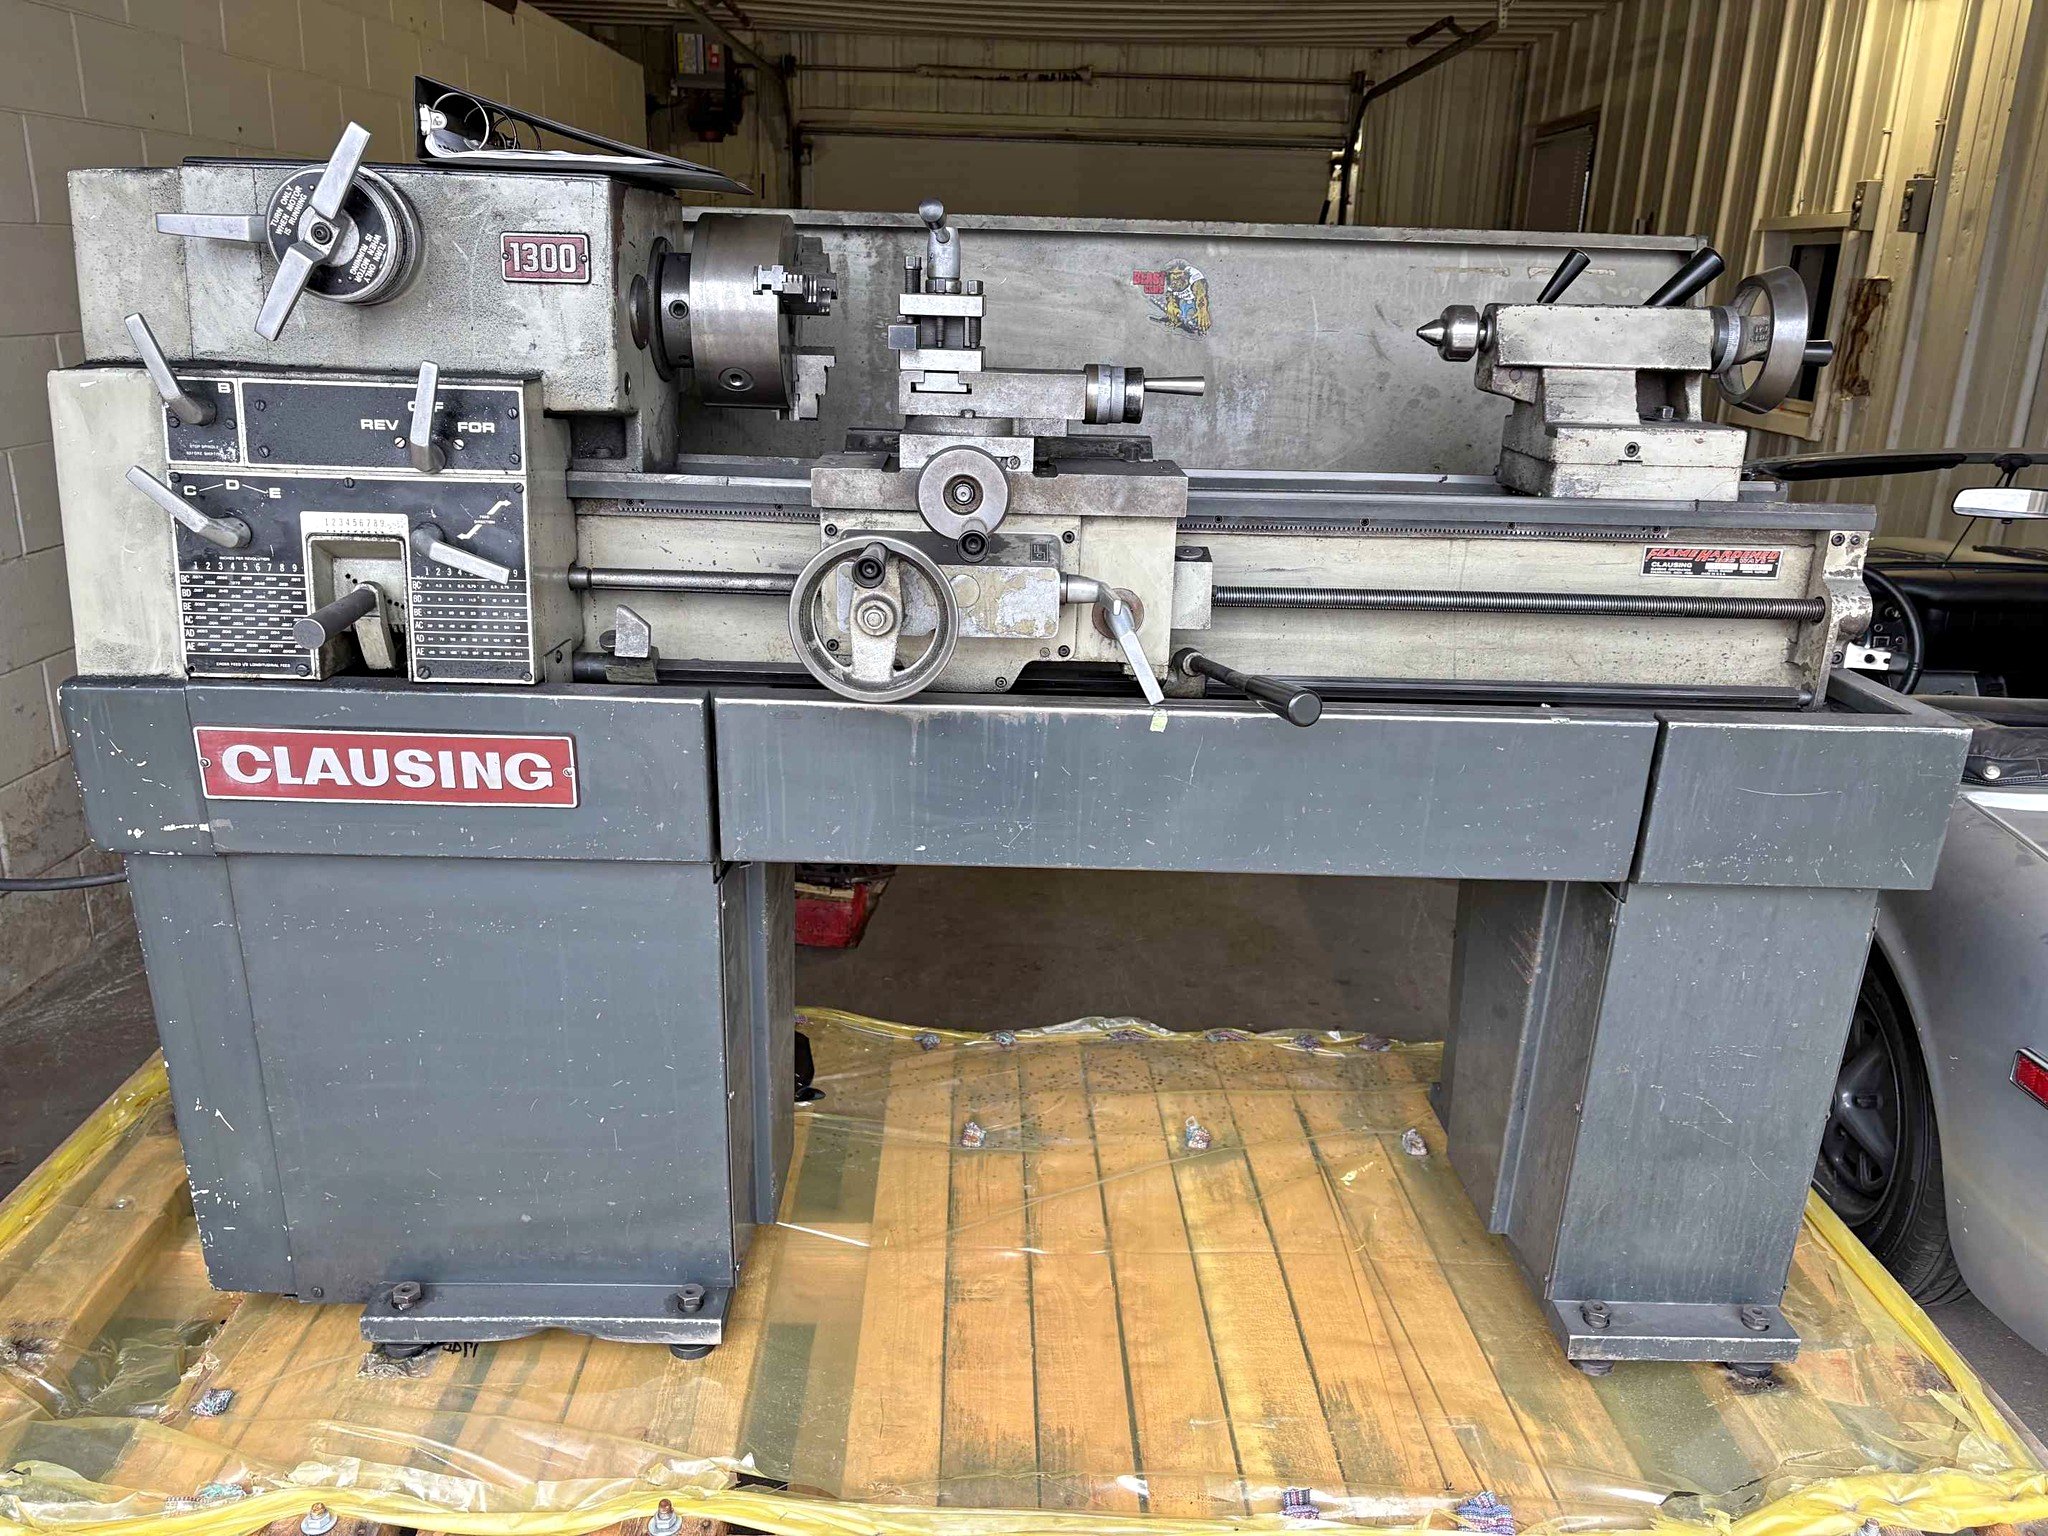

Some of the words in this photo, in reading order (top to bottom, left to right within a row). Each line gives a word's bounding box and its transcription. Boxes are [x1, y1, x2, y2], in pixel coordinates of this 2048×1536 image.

[270, 207, 283, 227] TURN
[280, 184, 294, 206] ONLY
[275, 213, 289, 235] WHEN
[286, 186, 302, 212] MOTOR
[284, 228, 292, 236] IS
[288, 194, 307, 226] RUNNING
[365, 233, 373, 241] IS
[368, 234, 382, 256] WHEN
[372, 242, 387, 262] TURN
[509, 242, 576, 273] 1300
[350, 243, 368, 276] RUNNING
[354, 256, 370, 283] MOTOR
[364, 263, 376, 284] ONLY
[218, 382, 231, 394] B
[408, 401, 444, 412] OF
[360, 418, 399, 430] REV
[457, 422, 496, 434] FOR
[183, 485, 197, 496] C
[226, 480, 240, 490] D
[268, 488, 282, 498] E
[1646, 548, 1698, 560] FLAME
[1694, 550, 1779, 562] HARDENED
[194, 562, 198, 570] 1
[205, 562, 211, 570] 2
[218, 562, 224, 570] 3
[230, 562, 235, 570] 4
[243, 562, 248, 571] 5
[255, 563, 261, 572] 6
[267, 563, 272, 572] 7
[279, 564, 285, 572] 8
[292, 564, 298, 572] 9
[436, 568, 441, 576] 2
[447, 568, 452, 576] 3
[512, 569, 518, 578] 9
[180, 574, 190, 584] BC
[412, 580, 422, 590] BC
[182, 588, 192, 598] BD
[413, 594, 422, 603] BD
[183, 602, 192, 611] BE
[414, 608, 422, 617] BE
[184, 615, 194, 624] AC
[415, 621, 424, 629] AC
[186, 629, 195, 638] AD
[416, 634, 425, 642] AD
[186, 642, 196, 651] AE
[416, 648, 425, 656] AE
[222, 743, 554, 791] CLAUSING
